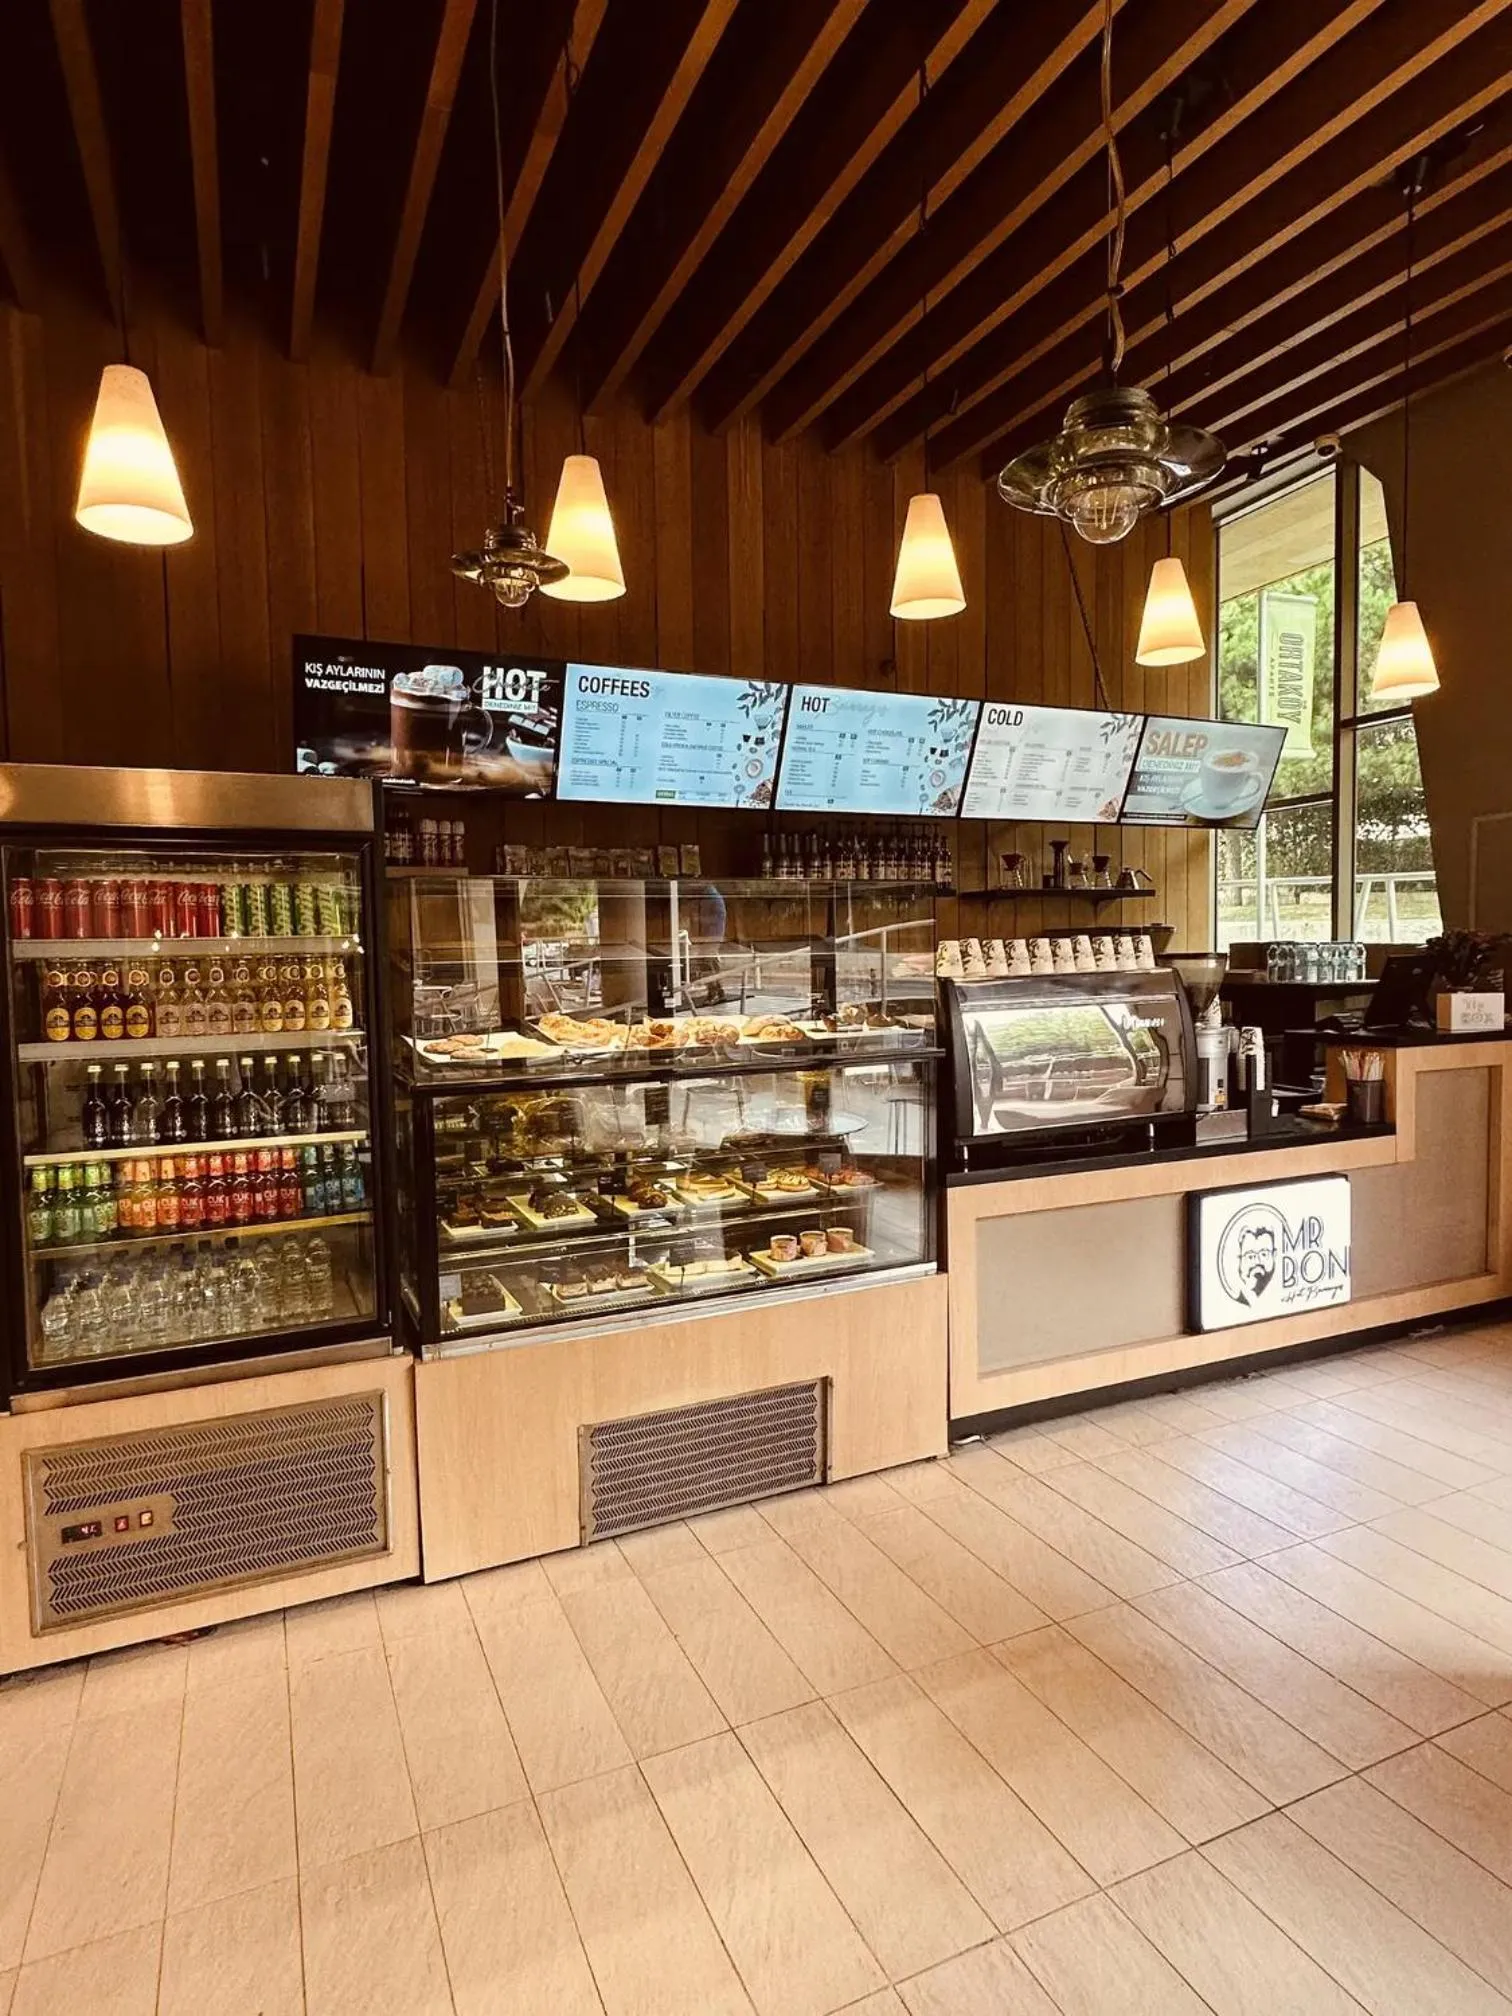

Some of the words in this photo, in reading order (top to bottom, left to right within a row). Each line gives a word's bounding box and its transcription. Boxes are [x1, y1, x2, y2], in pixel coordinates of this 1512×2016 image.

[305, 662, 323, 676] KIŞ
[325, 664, 386, 680] AYLARININ
[1277, 632, 1307, 724] ORTAKÖY
[304, 678, 385, 694] VAZGEÇİLMEZİ
[482, 665, 547, 703] HOT
[578, 675, 650, 699] COFFEES
[576, 700, 619, 714] ESPRESSO
[801, 696, 830, 713] HOT
[987, 708, 1023, 727] COLD
[1146, 731, 1208, 757] SALEP
[1282, 1215, 1324, 1253] MR
